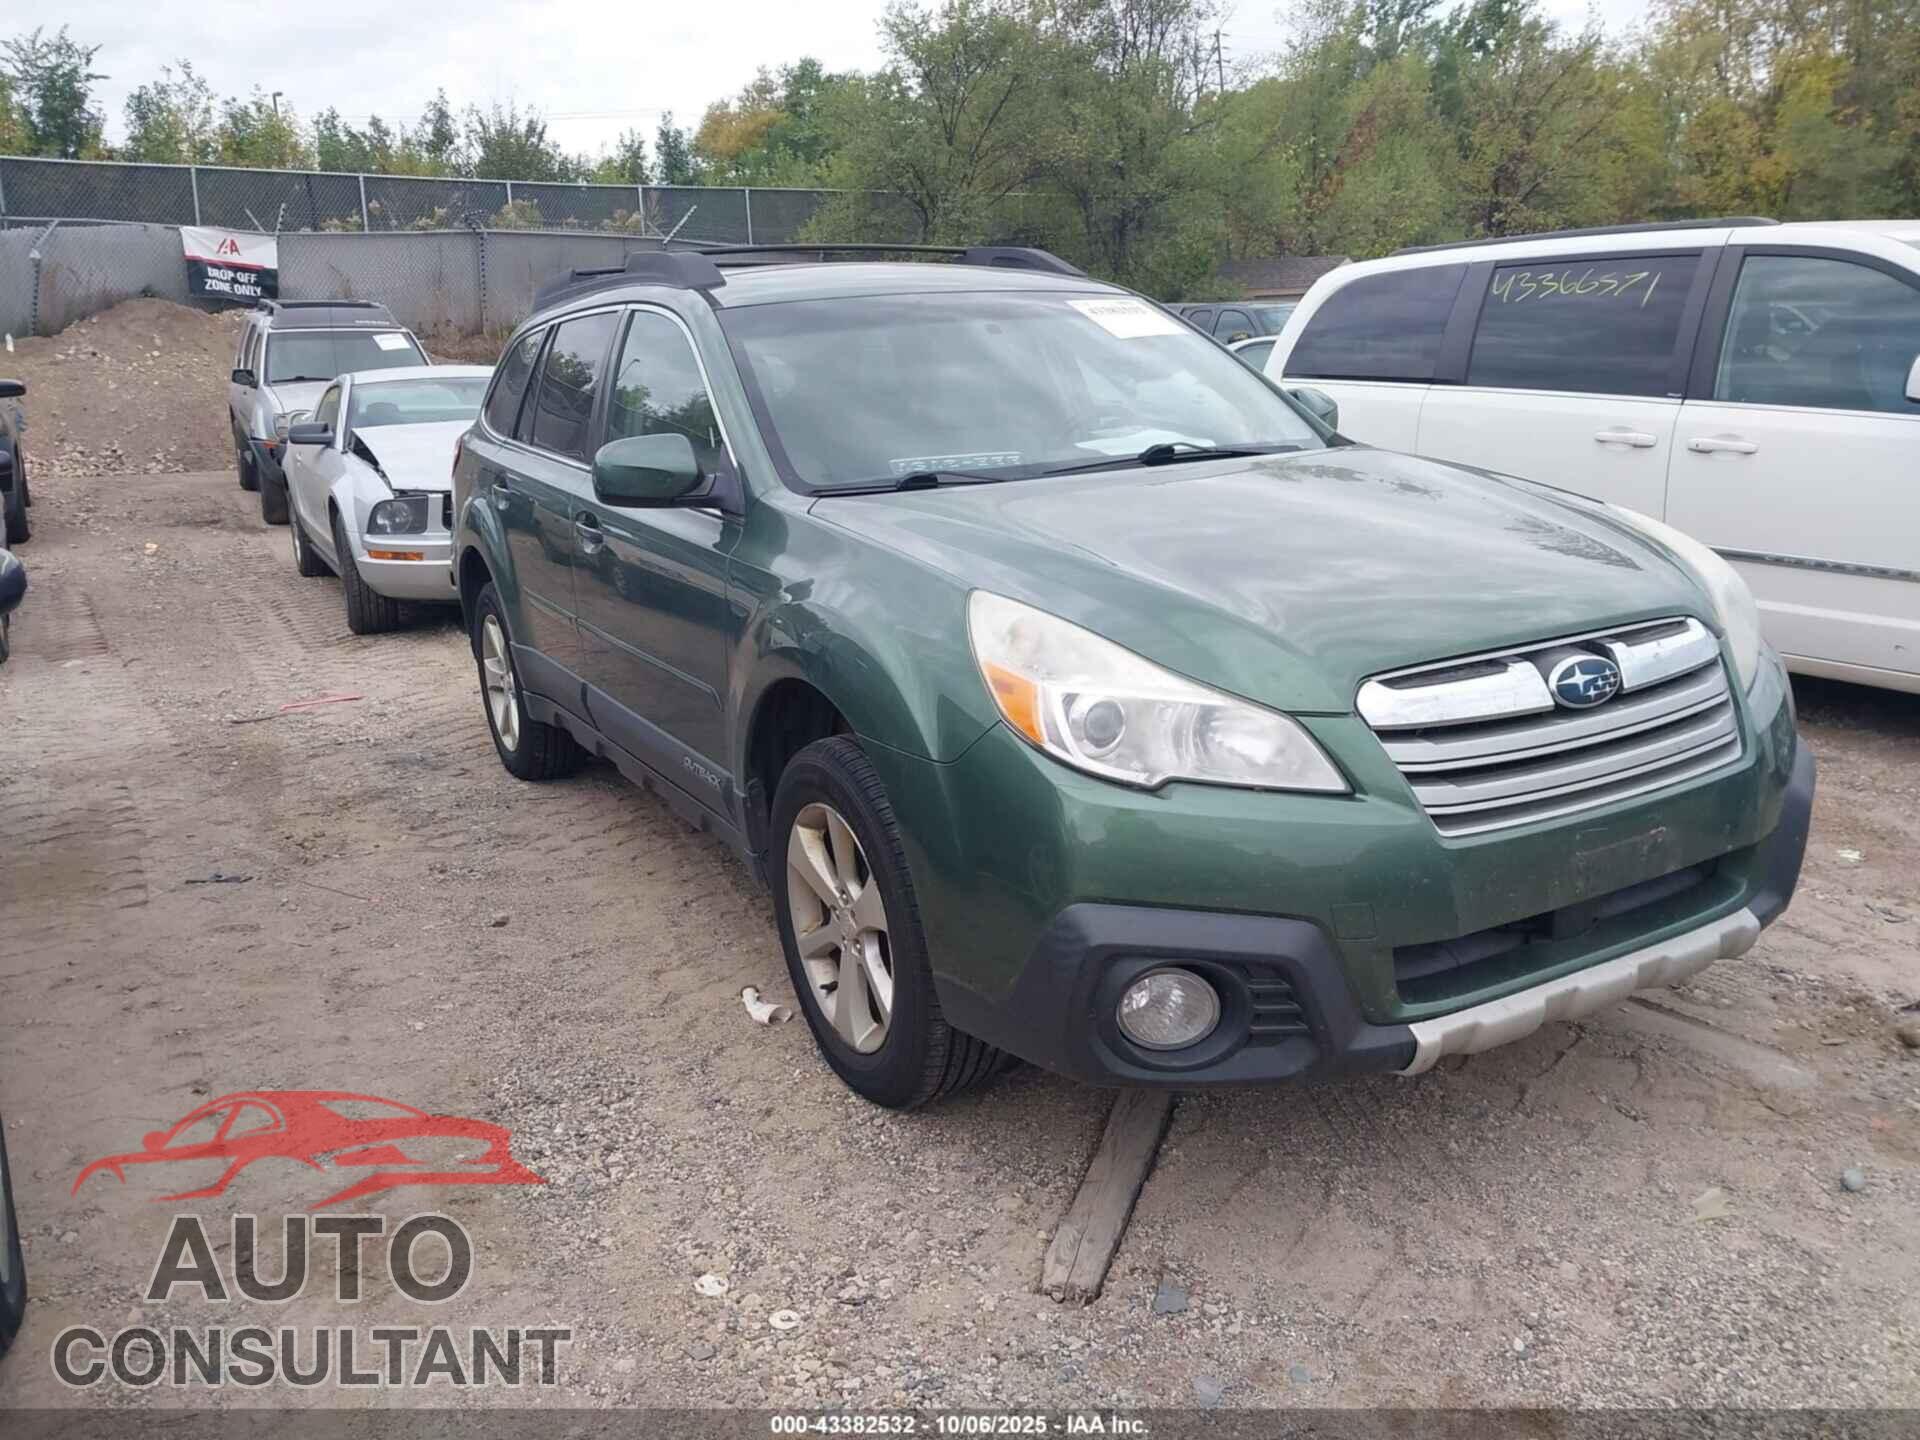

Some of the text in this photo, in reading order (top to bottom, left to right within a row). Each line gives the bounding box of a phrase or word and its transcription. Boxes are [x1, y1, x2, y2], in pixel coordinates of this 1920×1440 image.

[207, 266, 257, 284] DROP OFF
[205, 279, 262, 297] ZONE ONLY
